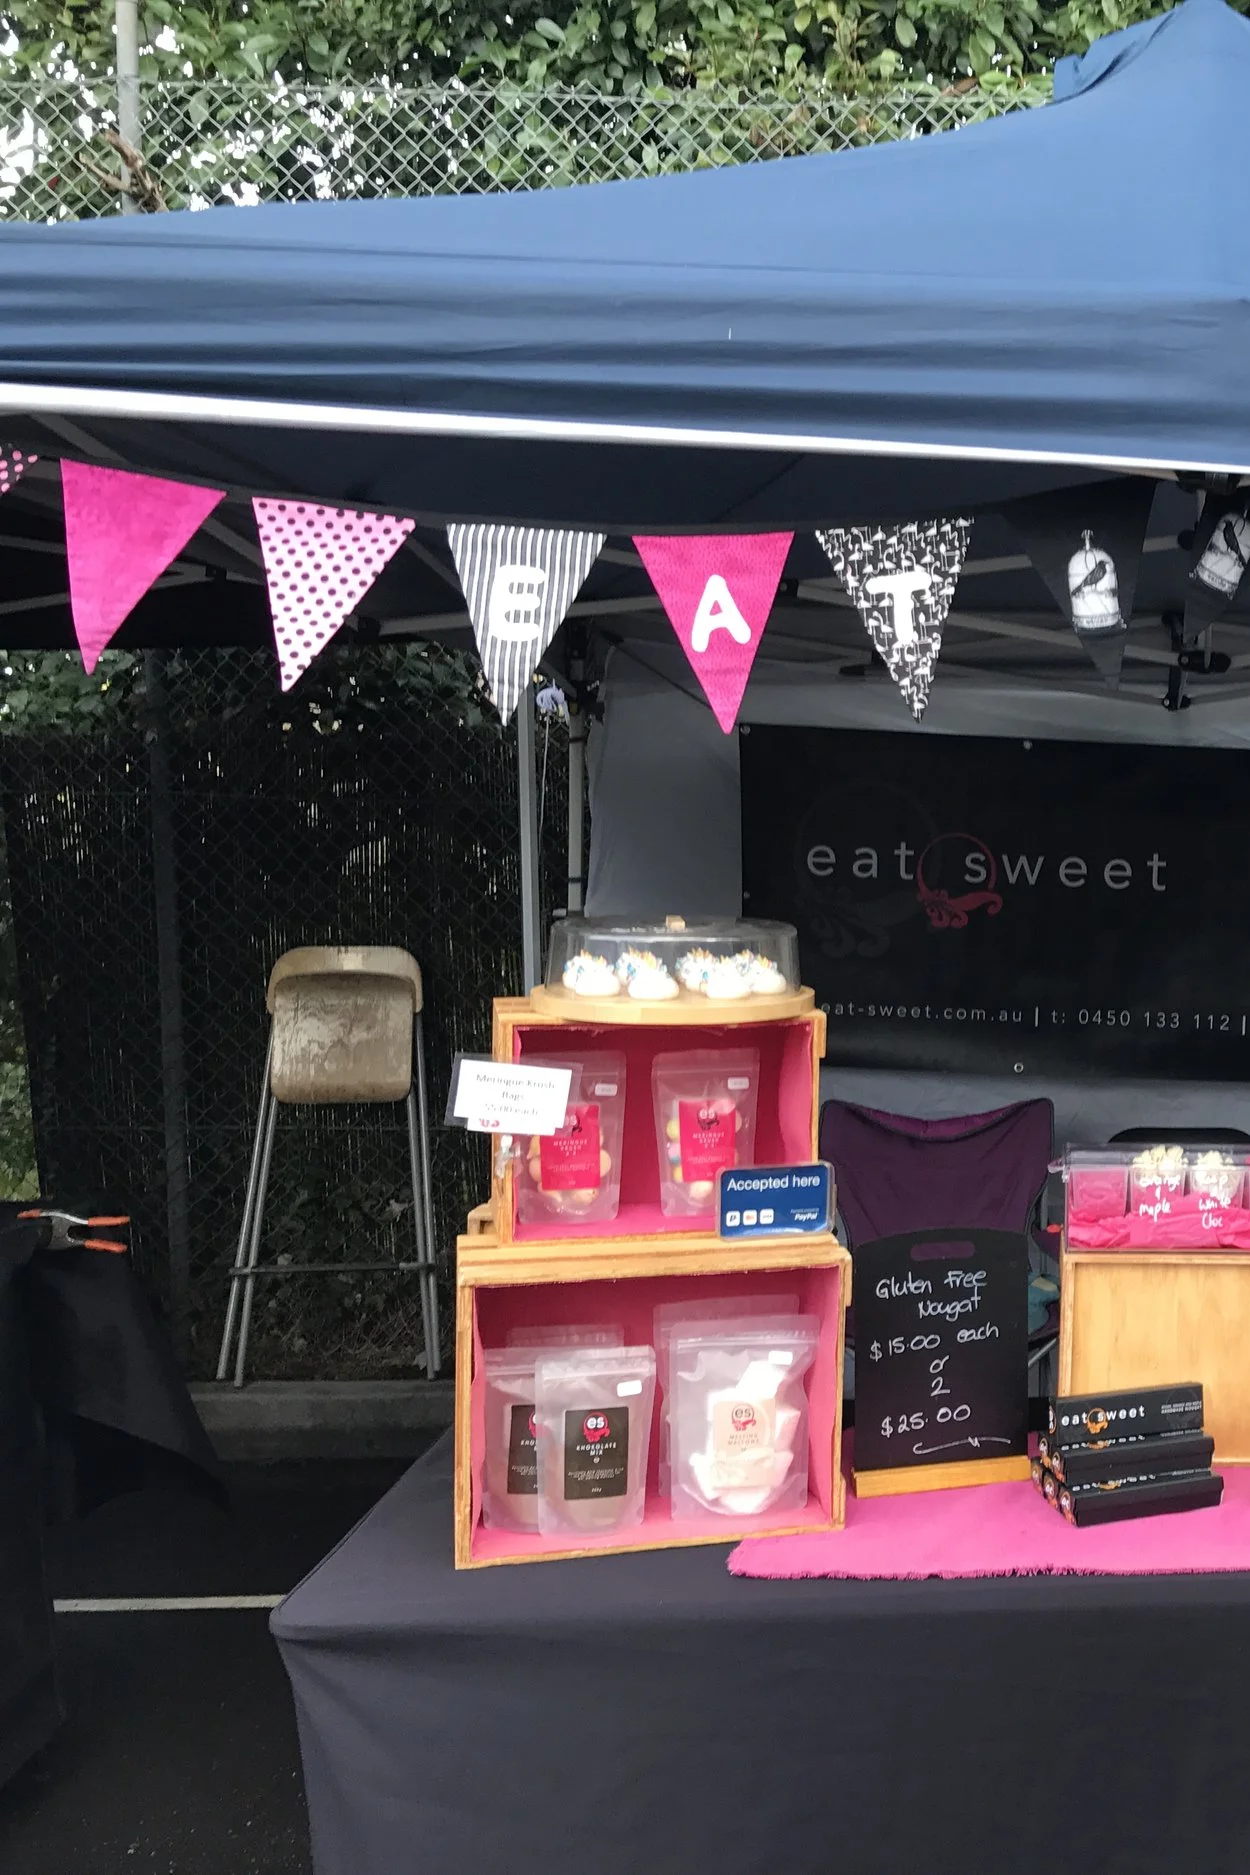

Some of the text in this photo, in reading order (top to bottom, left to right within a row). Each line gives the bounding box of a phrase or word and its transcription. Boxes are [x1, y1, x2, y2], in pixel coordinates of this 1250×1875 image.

[807, 841, 1168, 891] eat sweet
[1078, 1008, 1131, 1027] 0450
[1144, 1011, 1180, 1029] 133
[1193, 1014, 1230, 1032] 112
[727, 1175, 820, 1192] Accepted here
[794, 1212, 818, 1222] PayPal
[876, 1270, 987, 1299] Gluten Free
[918, 1286, 982, 1322] Nougat
[957, 1322, 999, 1343] each
[930, 1355, 949, 1374] or
[930, 1376, 950, 1397] 2
[1061, 1405, 1145, 1426] eat sweet
